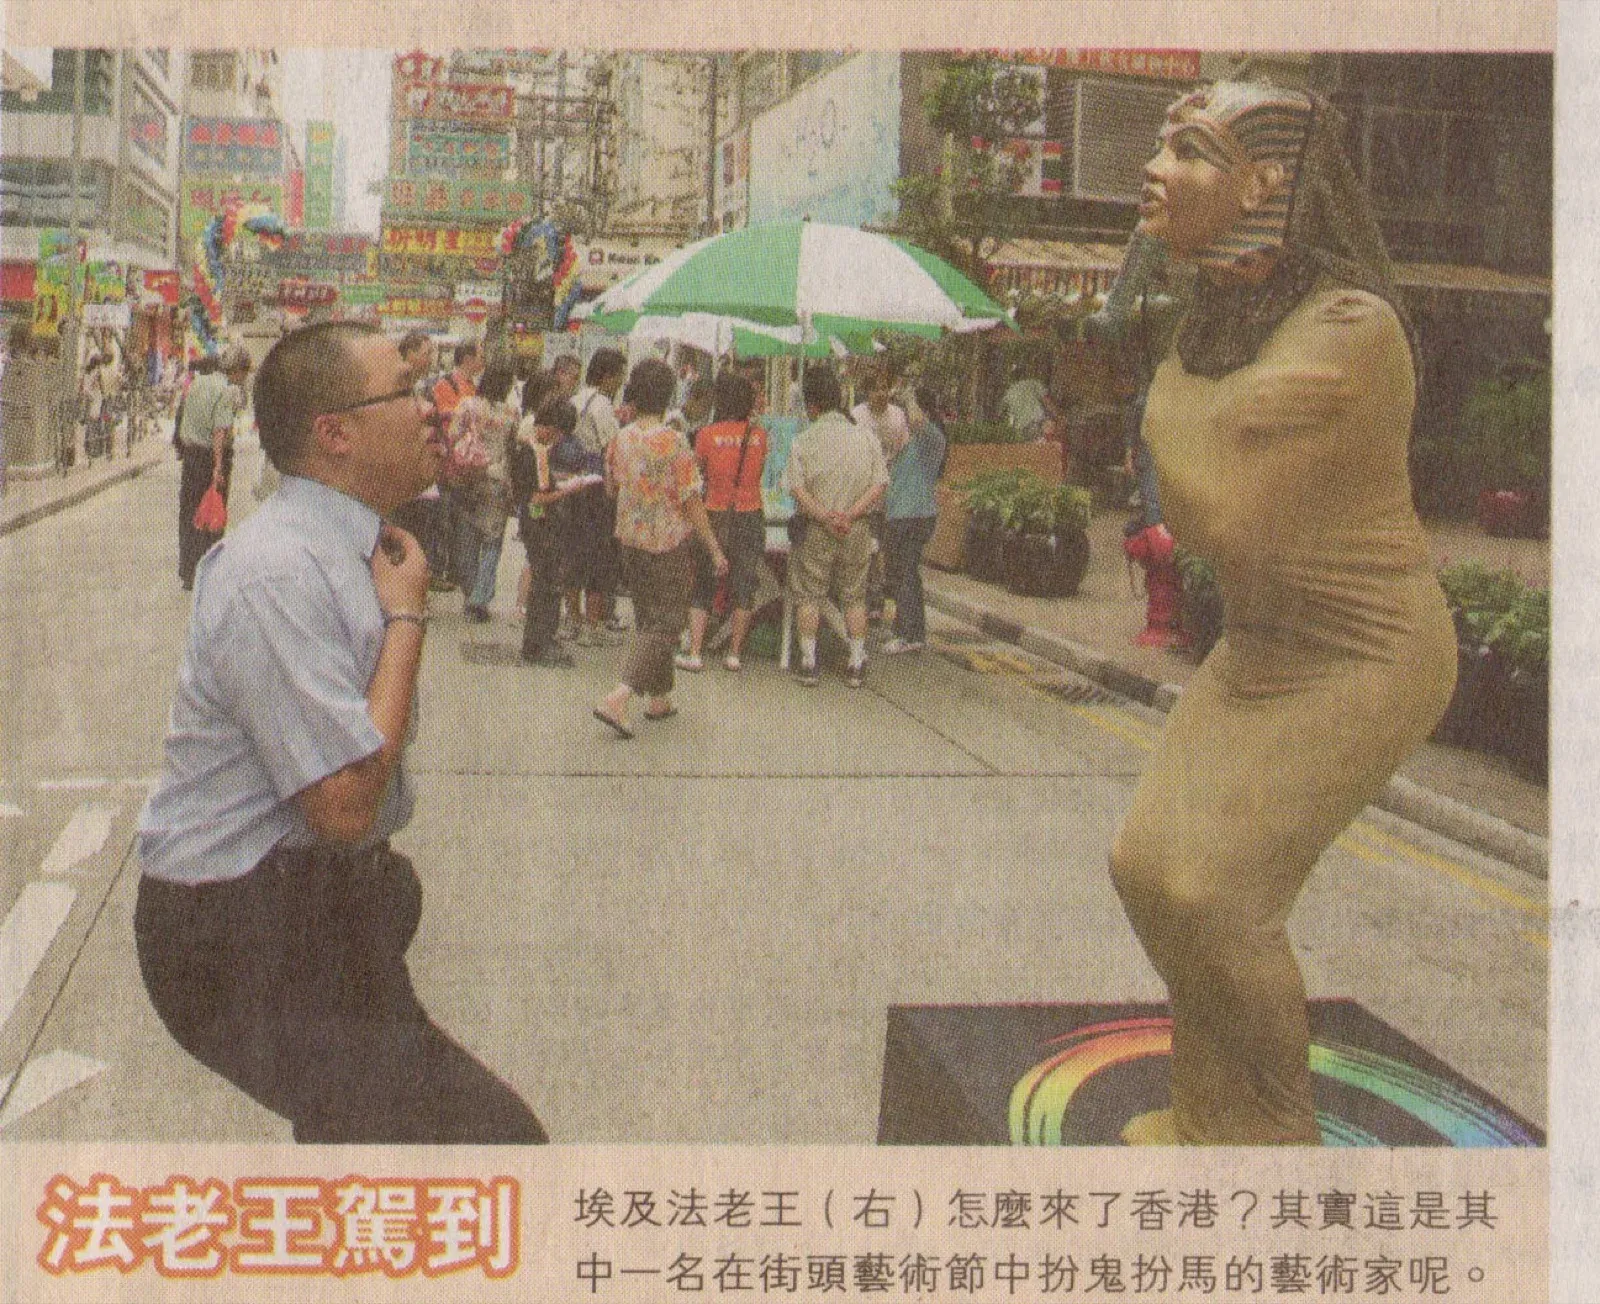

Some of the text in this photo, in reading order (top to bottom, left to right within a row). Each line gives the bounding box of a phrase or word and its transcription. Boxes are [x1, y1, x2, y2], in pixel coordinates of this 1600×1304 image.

[41, 1177, 519, 1276] 法老王駕到
